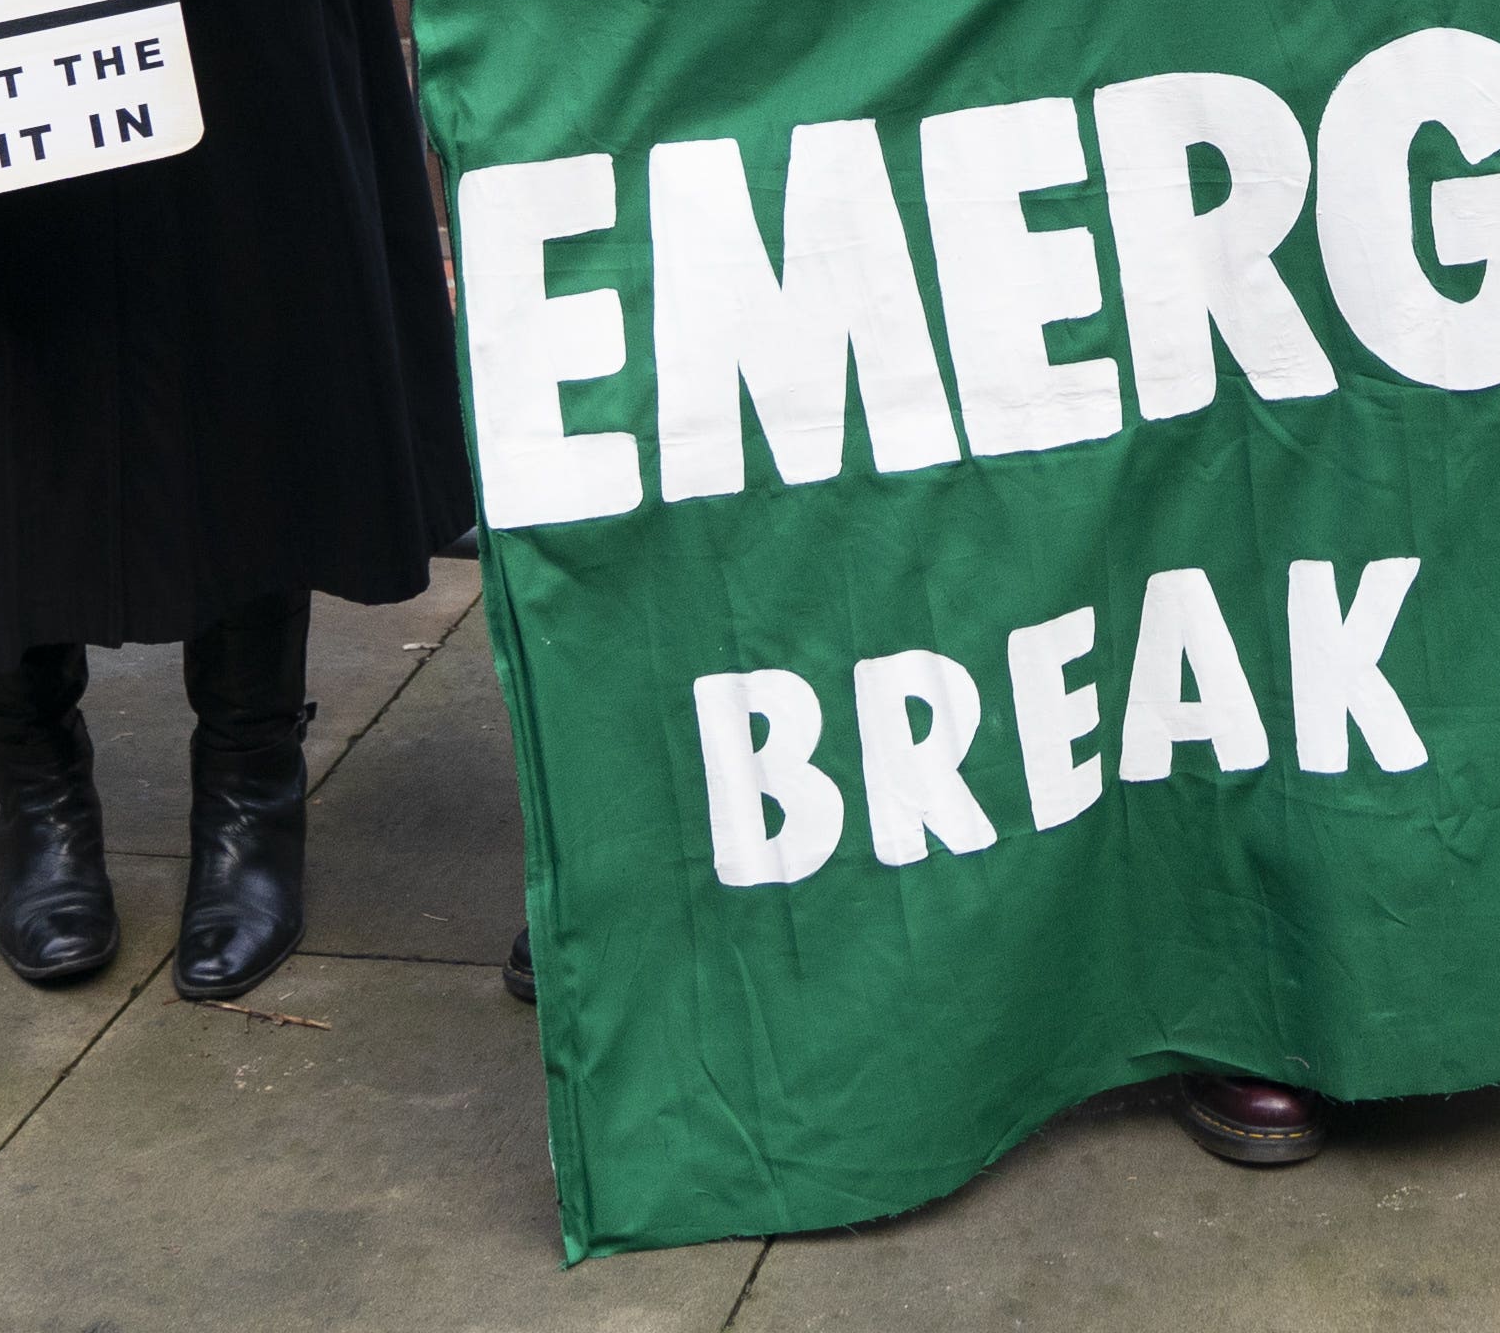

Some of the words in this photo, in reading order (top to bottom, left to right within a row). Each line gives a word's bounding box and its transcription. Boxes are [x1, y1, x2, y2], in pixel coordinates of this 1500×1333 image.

[54, 37, 166, 89] THE
[88, 103, 155, 149] IN
[693, 555, 1427, 888] BREAK
